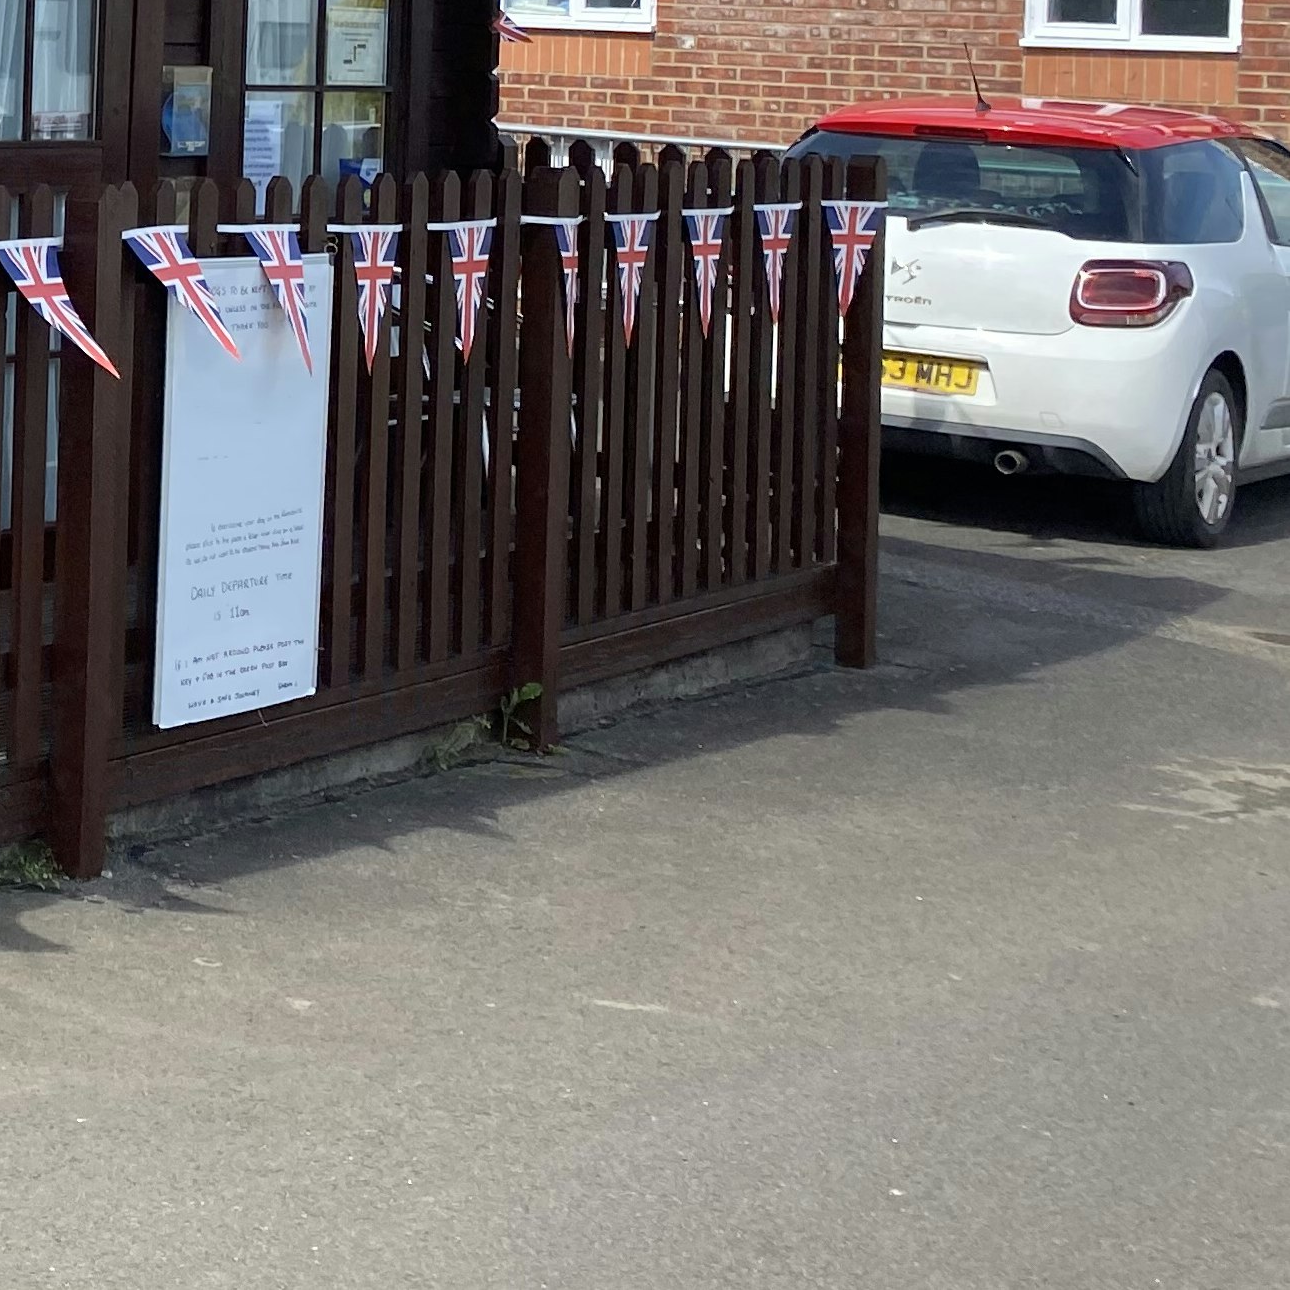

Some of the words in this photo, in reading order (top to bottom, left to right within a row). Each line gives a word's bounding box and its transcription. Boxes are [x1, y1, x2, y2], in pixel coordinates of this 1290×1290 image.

[886, 295, 932, 305] TROËN
[916, 360, 973, 389] MHJ
[191, 585, 215, 600] DAILY
[221, 575, 268, 594] DEPARTURE
